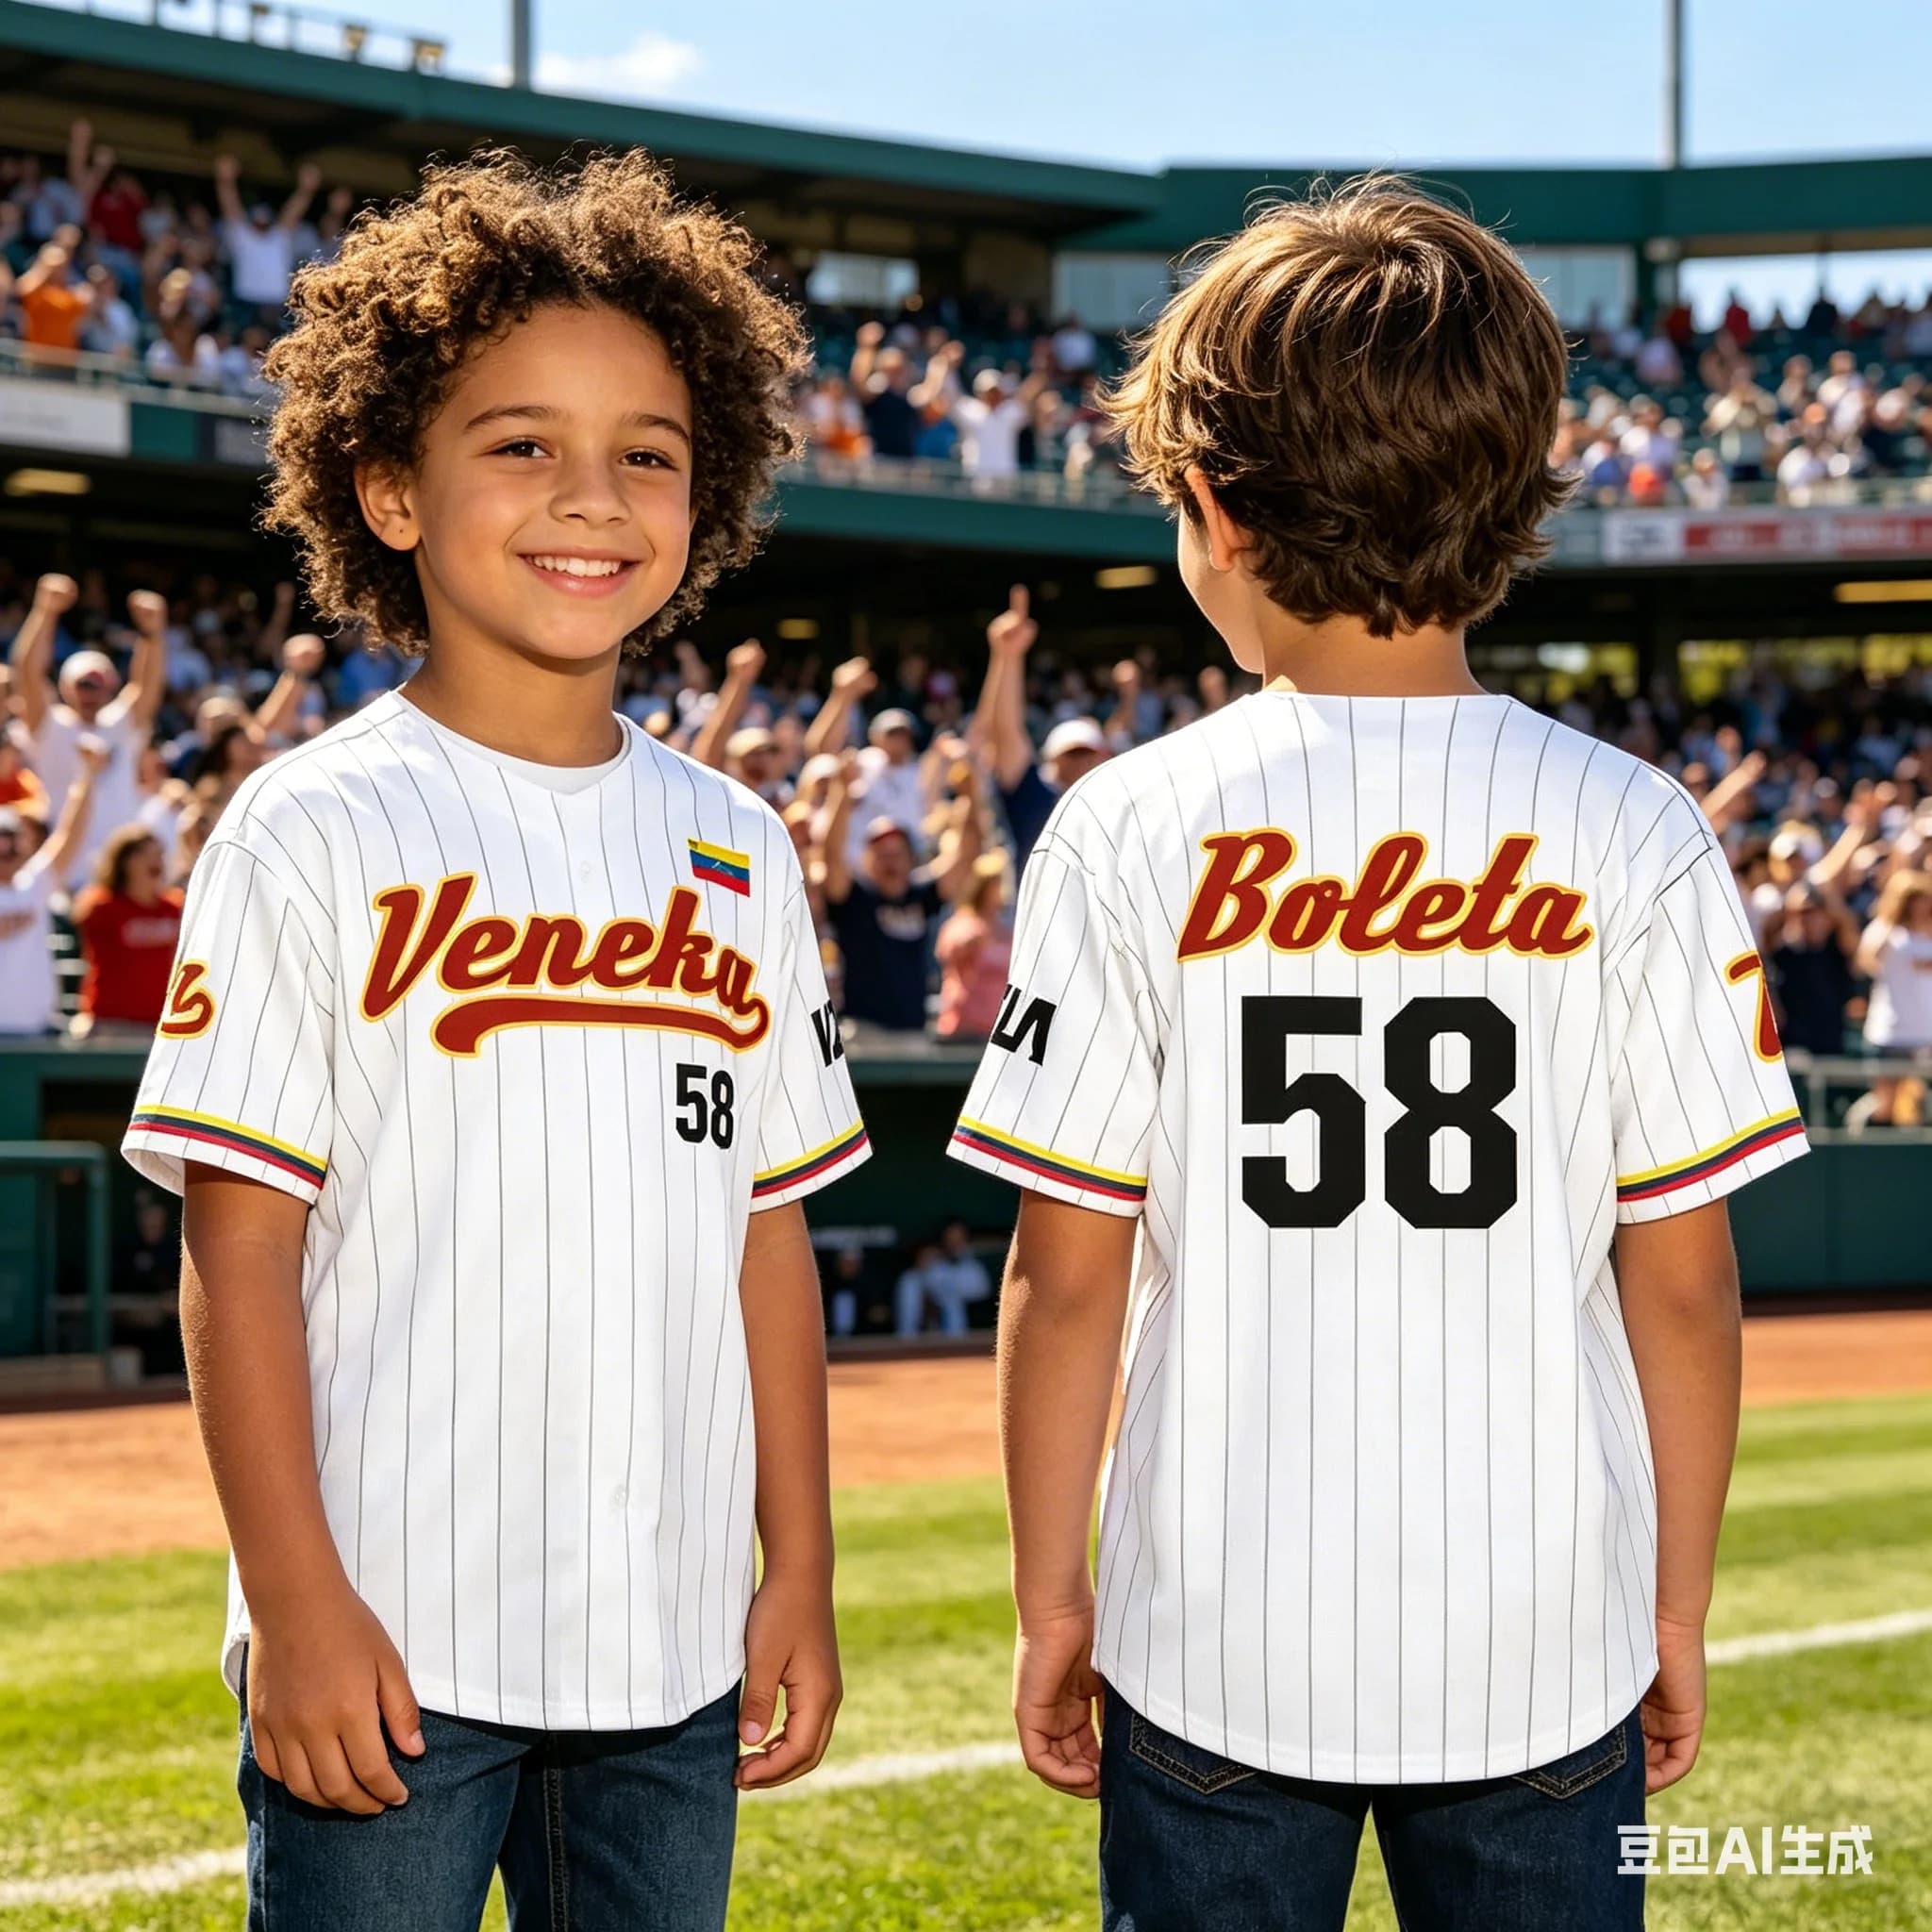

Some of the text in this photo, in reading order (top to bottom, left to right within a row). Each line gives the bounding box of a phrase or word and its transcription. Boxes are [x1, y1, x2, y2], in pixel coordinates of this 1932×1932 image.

[359, 872, 771, 1058] Veneka
[1177, 827, 1595, 963] Boleta
[676, 1062, 734, 1150] 58
[1241, 995, 1517, 1229] 58
